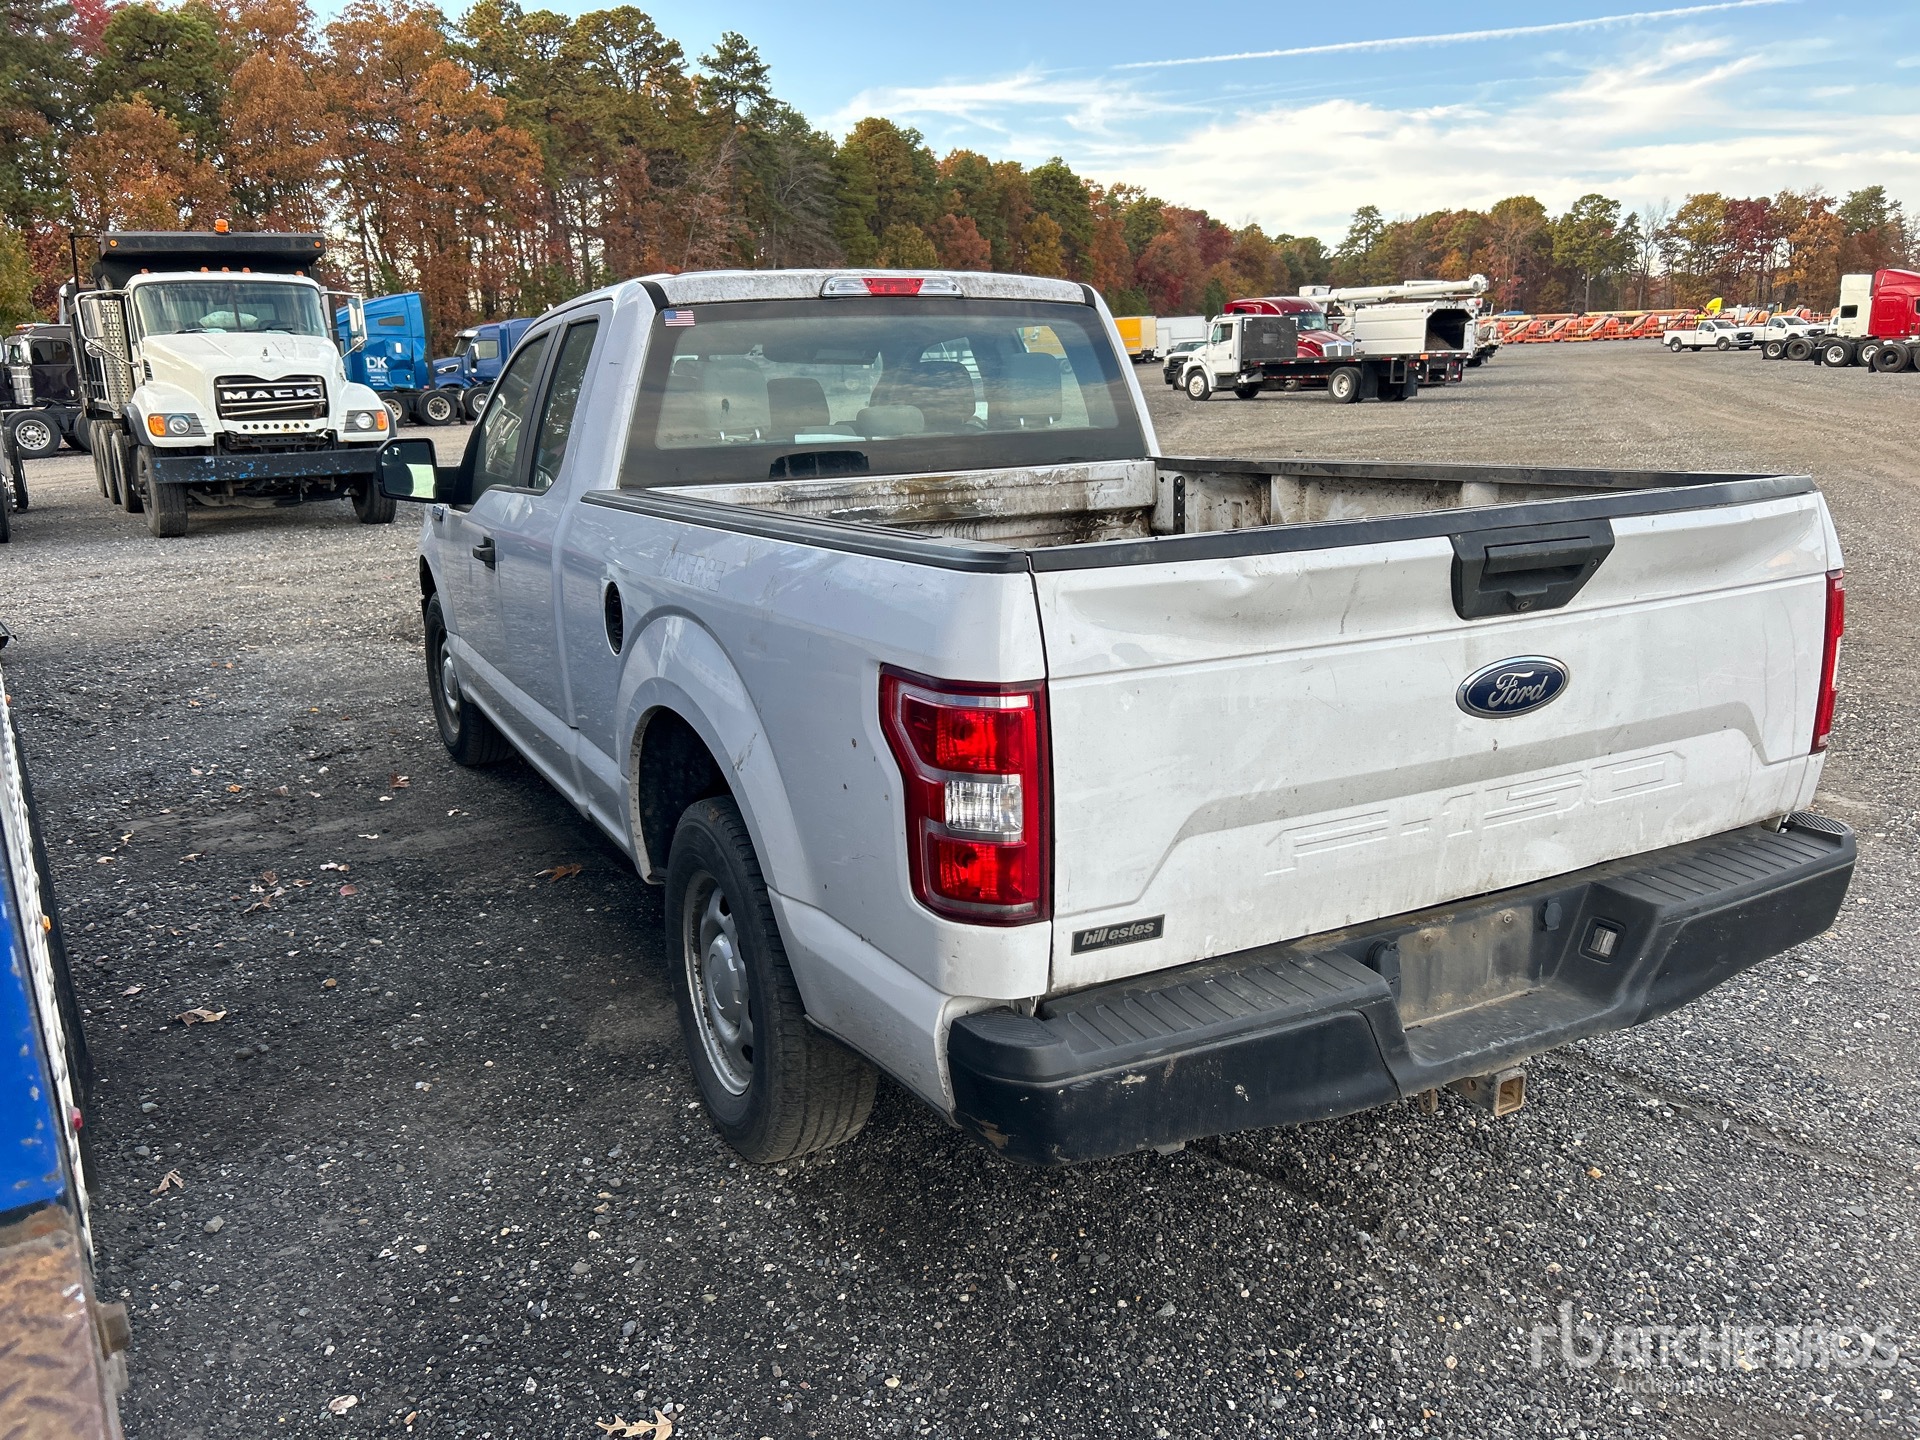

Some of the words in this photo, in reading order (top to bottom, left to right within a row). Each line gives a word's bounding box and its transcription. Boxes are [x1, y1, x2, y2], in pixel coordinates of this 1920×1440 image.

[365, 356, 389, 369] DK
[223, 387, 321, 401] MACK
[1487, 670, 1549, 708] Ford
[1264, 750, 1687, 876] F-150
[1081, 927, 1110, 946] bill
[1108, 922, 1155, 940] estes
